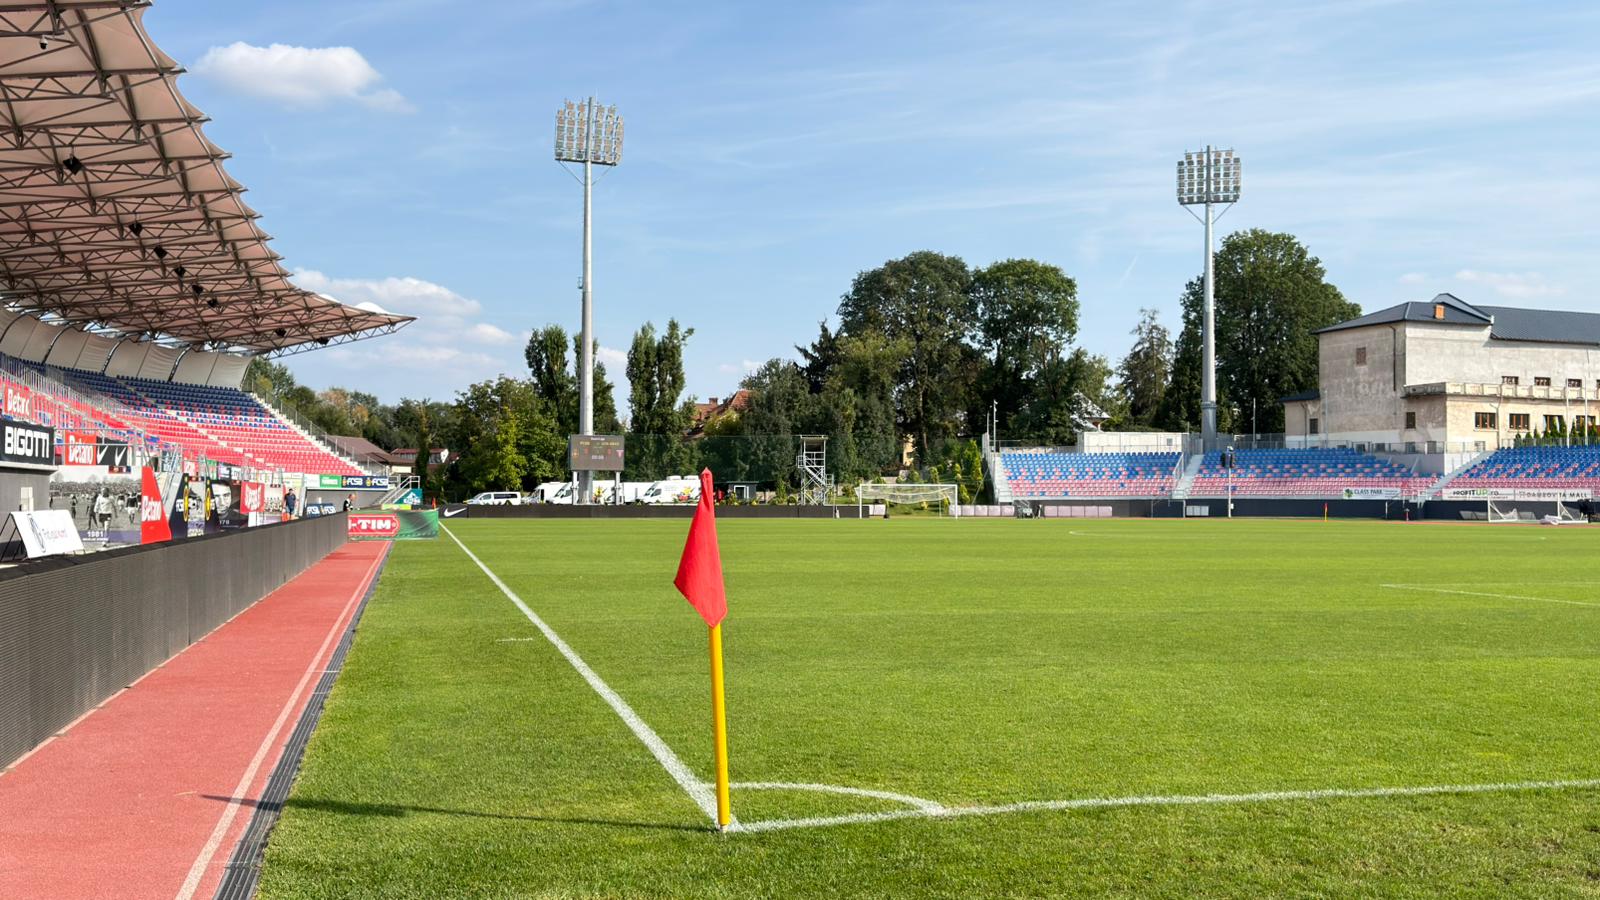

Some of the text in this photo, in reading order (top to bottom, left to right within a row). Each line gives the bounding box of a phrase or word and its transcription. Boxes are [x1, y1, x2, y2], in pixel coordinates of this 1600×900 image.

[4, 425, 50, 459] BIGOTTI
[68, 434, 94, 465] Betano
[347, 477, 364, 486] FCSB
[141, 495, 162, 522] Betano
